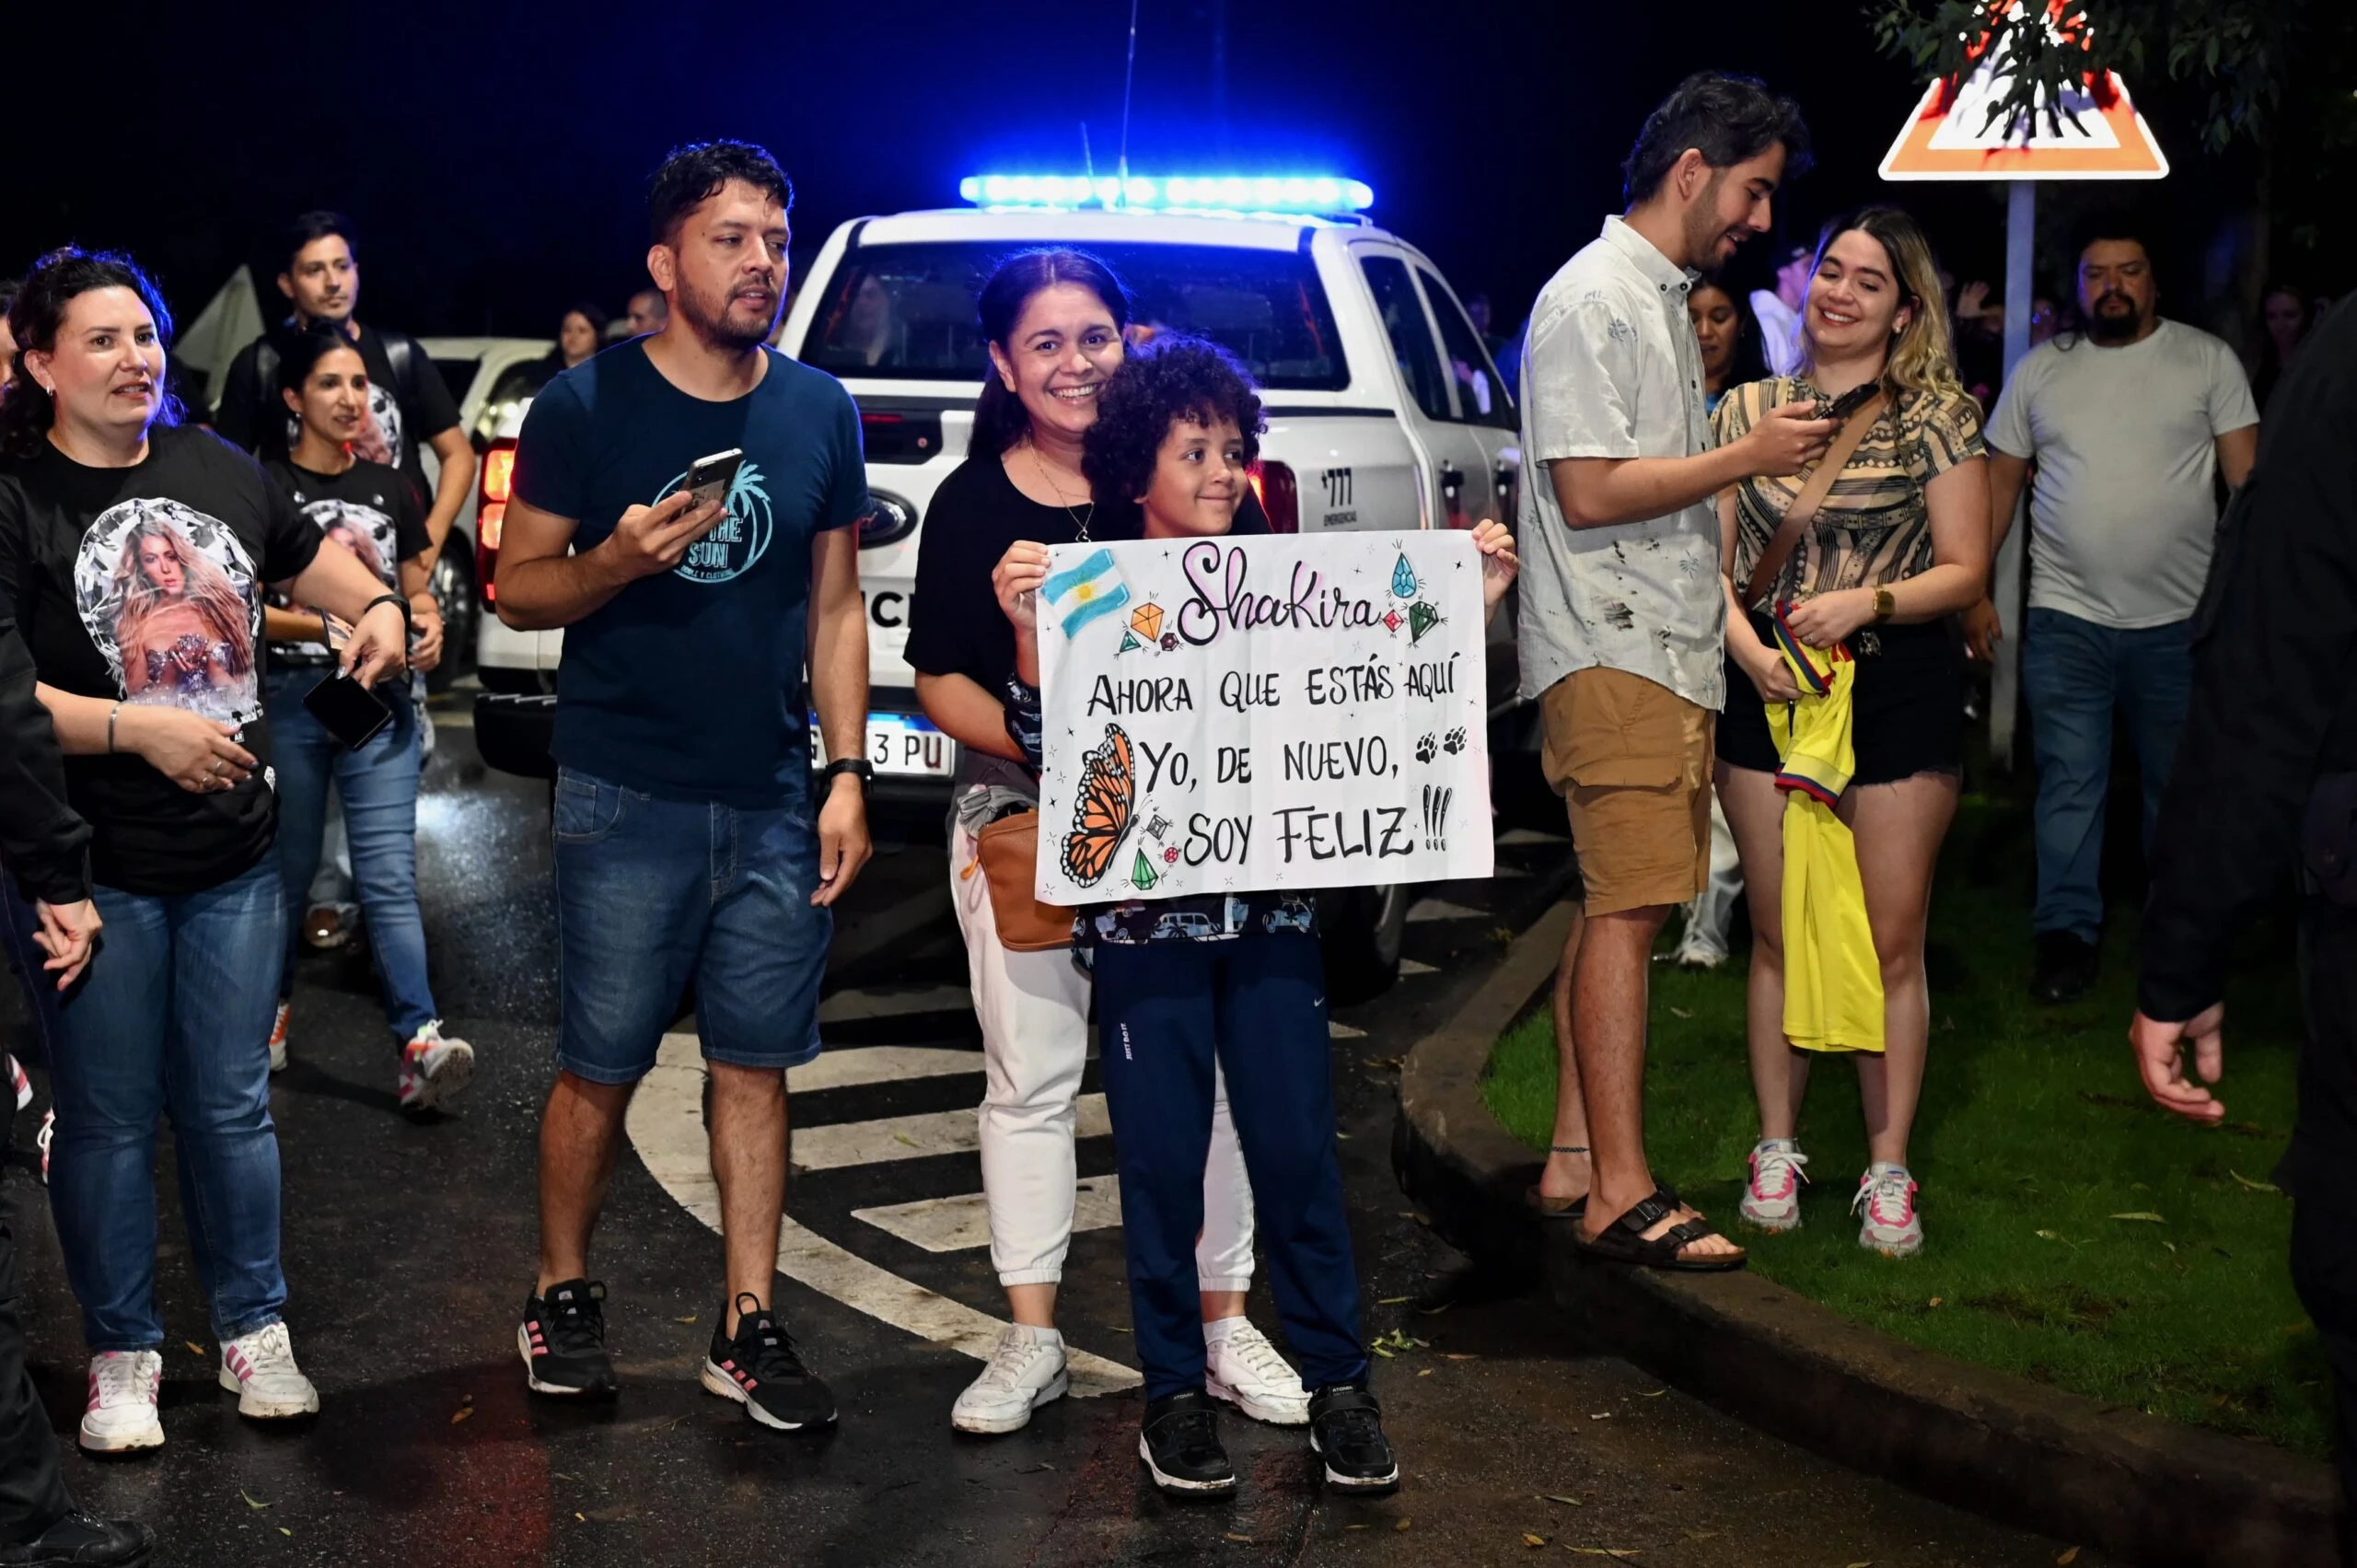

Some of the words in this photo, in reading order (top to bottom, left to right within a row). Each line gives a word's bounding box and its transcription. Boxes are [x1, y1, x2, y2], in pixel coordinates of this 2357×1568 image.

[689, 543, 729, 567] SUN
[1087, 673, 1194, 716] AHORA
[1219, 670, 1281, 713] QUE
[1305, 653, 1395, 705] ESTÁS
[1404, 651, 1460, 703] AQUÍ
[905, 735, 942, 769] PU
[1217, 747, 1253, 784] DE
[1283, 736, 1399, 782] NUEVO,
[1183, 812, 1253, 866] SOY
[1122, 1030, 1130, 1042] DO
[1123, 1042, 1132, 1061] JUST
